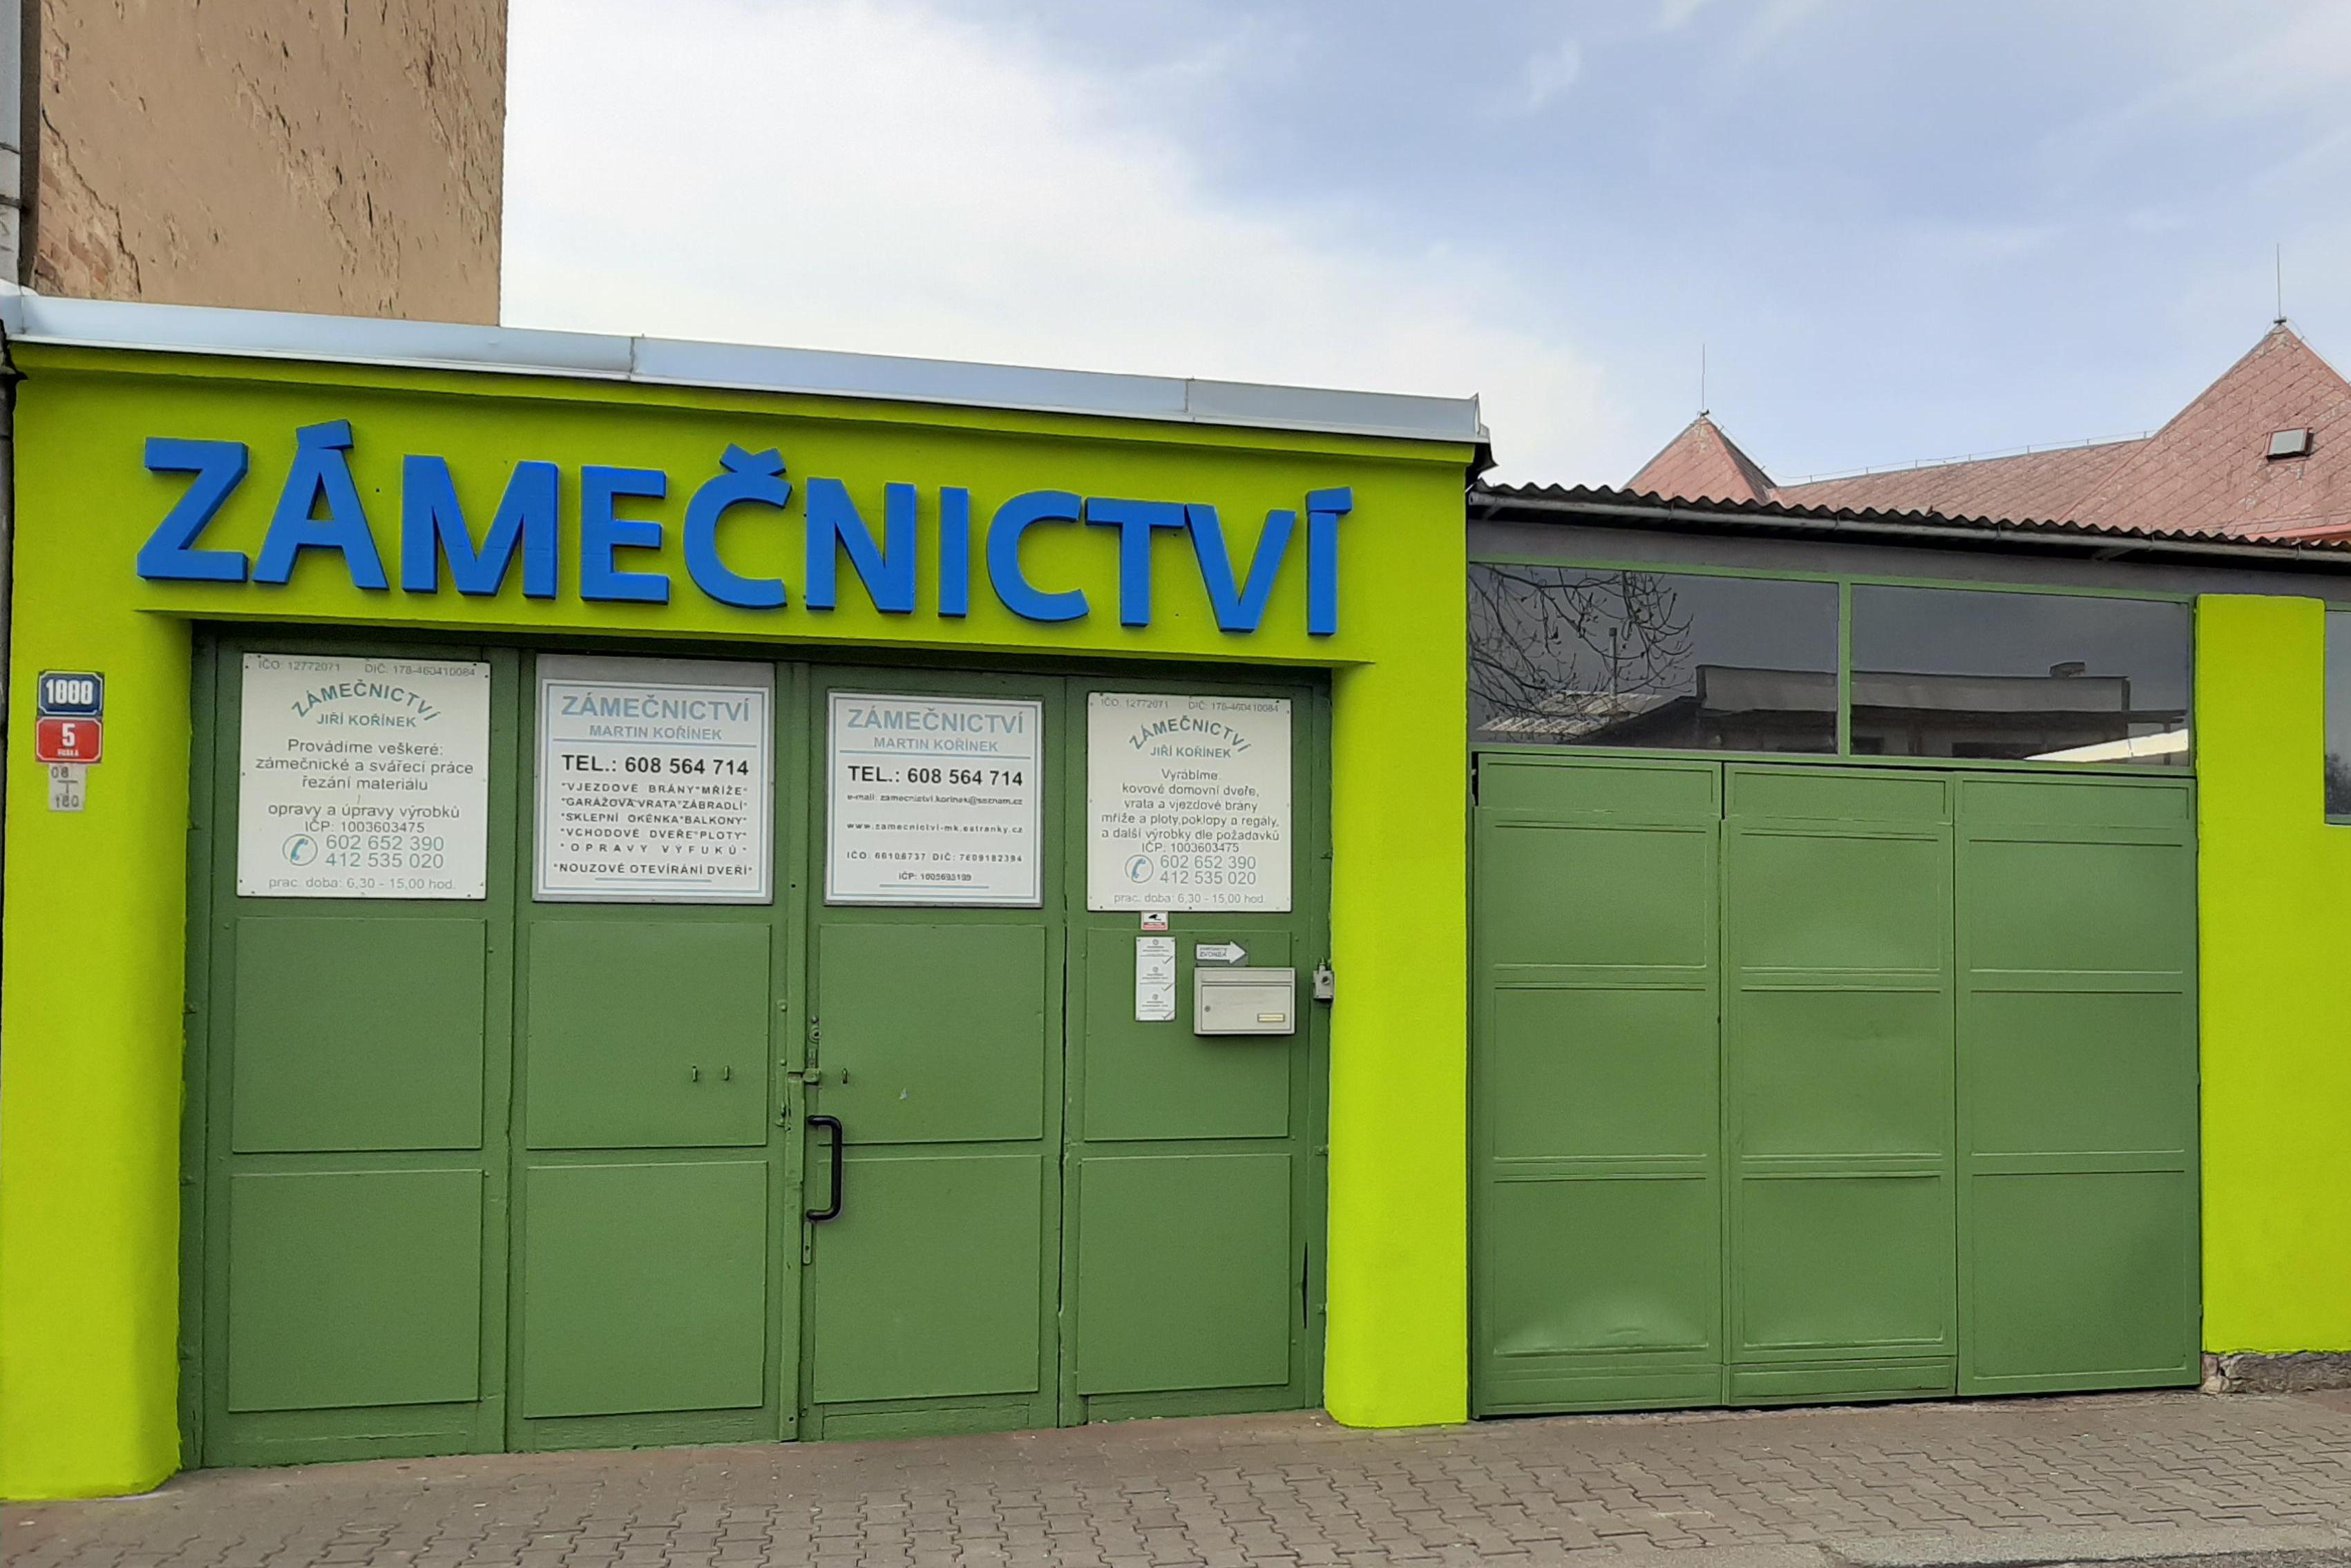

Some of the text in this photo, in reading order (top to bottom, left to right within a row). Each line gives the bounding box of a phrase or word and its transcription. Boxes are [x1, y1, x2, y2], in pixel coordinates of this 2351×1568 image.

[137, 419, 1354, 637] ZÁMEČNICTVÍ
[291, 678, 441, 721] ZÁMEČNICTVÍ
[561, 691, 750, 723] ZÁMEČNICTVÍ
[316, 711, 417, 728] JIŘÍ KOŘÍNEK
[846, 705, 1023, 734] ZÁMEČNICTVÍ
[62, 723, 76, 747] 5
[589, 724, 722, 741] MARTIN KOŘÍNEK
[1130, 716, 1252, 752] ZÁMEČNICTVÍ
[873, 736, 999, 752] MARTIN KOŘÍNEK
[1150, 745, 1231, 758] JIŘÍ KOŘÍNEK
[256, 757, 350, 772] zámečnické
[354, 761, 365, 772] a
[430, 762, 474, 776] práce
[562, 754, 749, 776] TEL.: 608 564 714
[301, 775, 428, 792] řezání materiálu
[848, 765, 1023, 786] TEL.: 608 564 714
[1122, 783, 1165, 794] kovové
[1168, 784, 1219, 796] domovní
[268, 804, 460, 820] opravy a úpravy výrobků
[1124, 799, 1258, 813] vrata a vjezdové brány
[1101, 812, 1135, 823] mříže
[1139, 815, 1147, 823] a
[341, 821, 425, 833] 1003603475
[1113, 828, 1141, 838] další
[1145, 830, 1192, 841] výrobky
[1194, 830, 1213, 839] dle
[1217, 830, 1279, 842] požadavků
[325, 834, 444, 852] 602 652 390
[325, 853, 444, 870] 412 535 020
[1160, 855, 1256, 869] 602 652 390
[1160, 871, 1256, 885] 412 535 020
